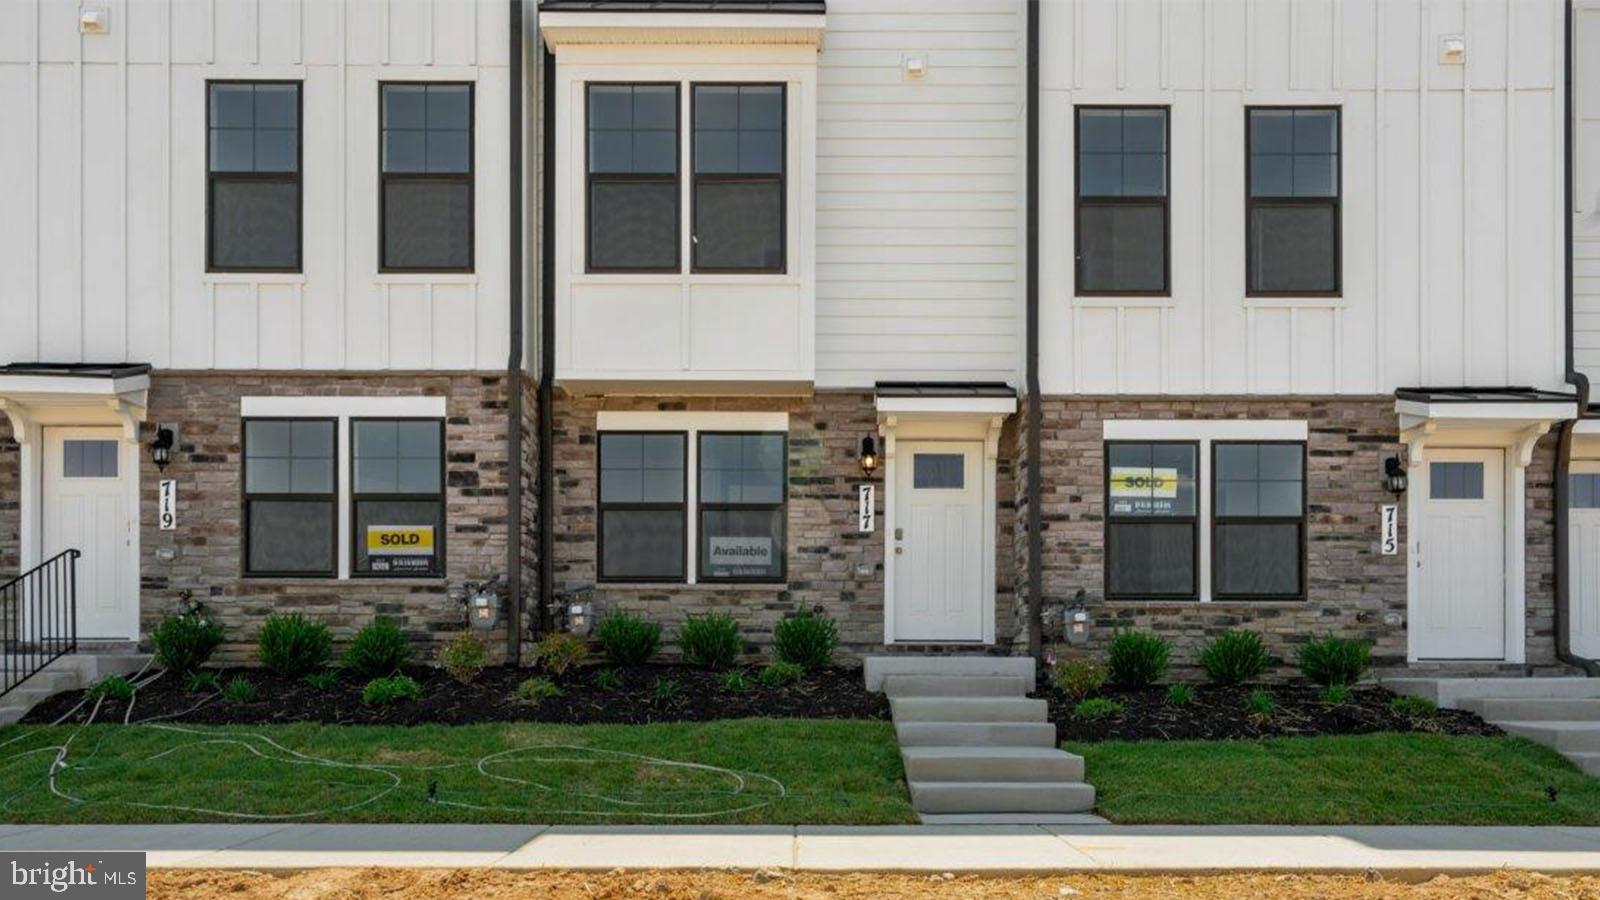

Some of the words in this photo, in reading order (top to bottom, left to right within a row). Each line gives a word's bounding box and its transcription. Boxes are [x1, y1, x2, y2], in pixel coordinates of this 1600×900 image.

[1125, 476, 1164, 488] SOLD
[162, 481, 173, 528] 719
[862, 486, 872, 530] 717
[380, 533, 420, 546] SOLD
[1385, 507, 1395, 553] 715
[713, 545, 769, 557] Available
